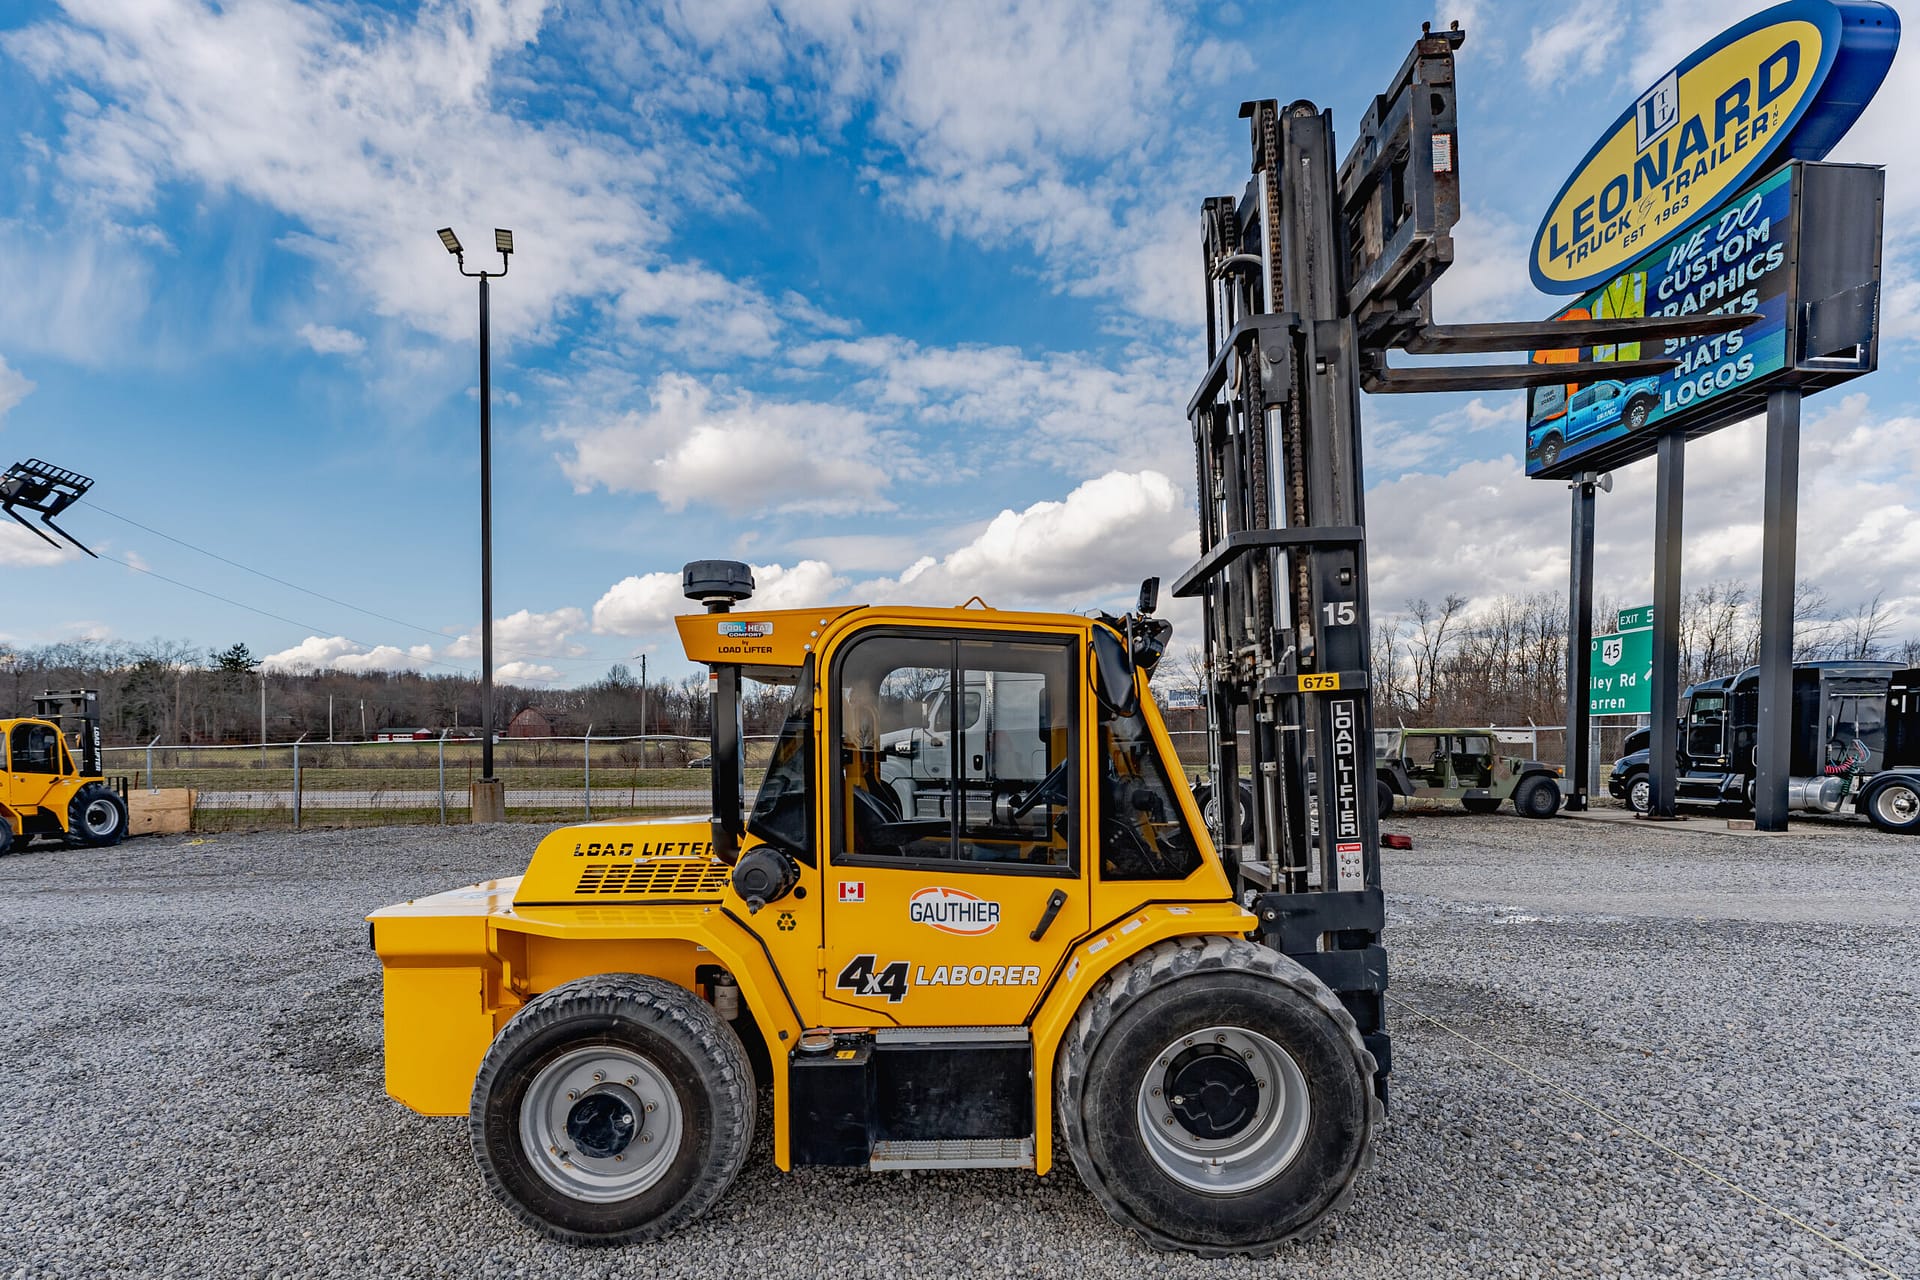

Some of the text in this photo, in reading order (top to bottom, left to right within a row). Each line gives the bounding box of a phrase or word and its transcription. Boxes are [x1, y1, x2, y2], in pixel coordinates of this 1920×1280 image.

[1549, 40, 1800, 263] LEONARD
[1566, 209, 1632, 269] TRUCK
[1662, 112, 1769, 202] TRAILER
[1623, 195, 1690, 248] EST 1963
[1665, 192, 1763, 273] WE DO
[1658, 217, 1770, 300] CUSTOM
[1674, 329, 1744, 380] HATS
[1664, 353, 1755, 412] LOGOS
[1323, 601, 1356, 626] 15
[1620, 613, 1640, 625] EXIT
[1604, 643, 1620, 660] 45
[1303, 676, 1335, 689] 675
[1590, 672, 1637, 692] iley Rd
[1591, 698, 1626, 710] arren
[1335, 704, 1353, 755] LOAD
[1338, 759, 1356, 835] LIFTER
[573, 842, 635, 857] LOAD
[910, 901, 1000, 923] GAUTHIER
[914, 965, 1041, 987] LABORER
